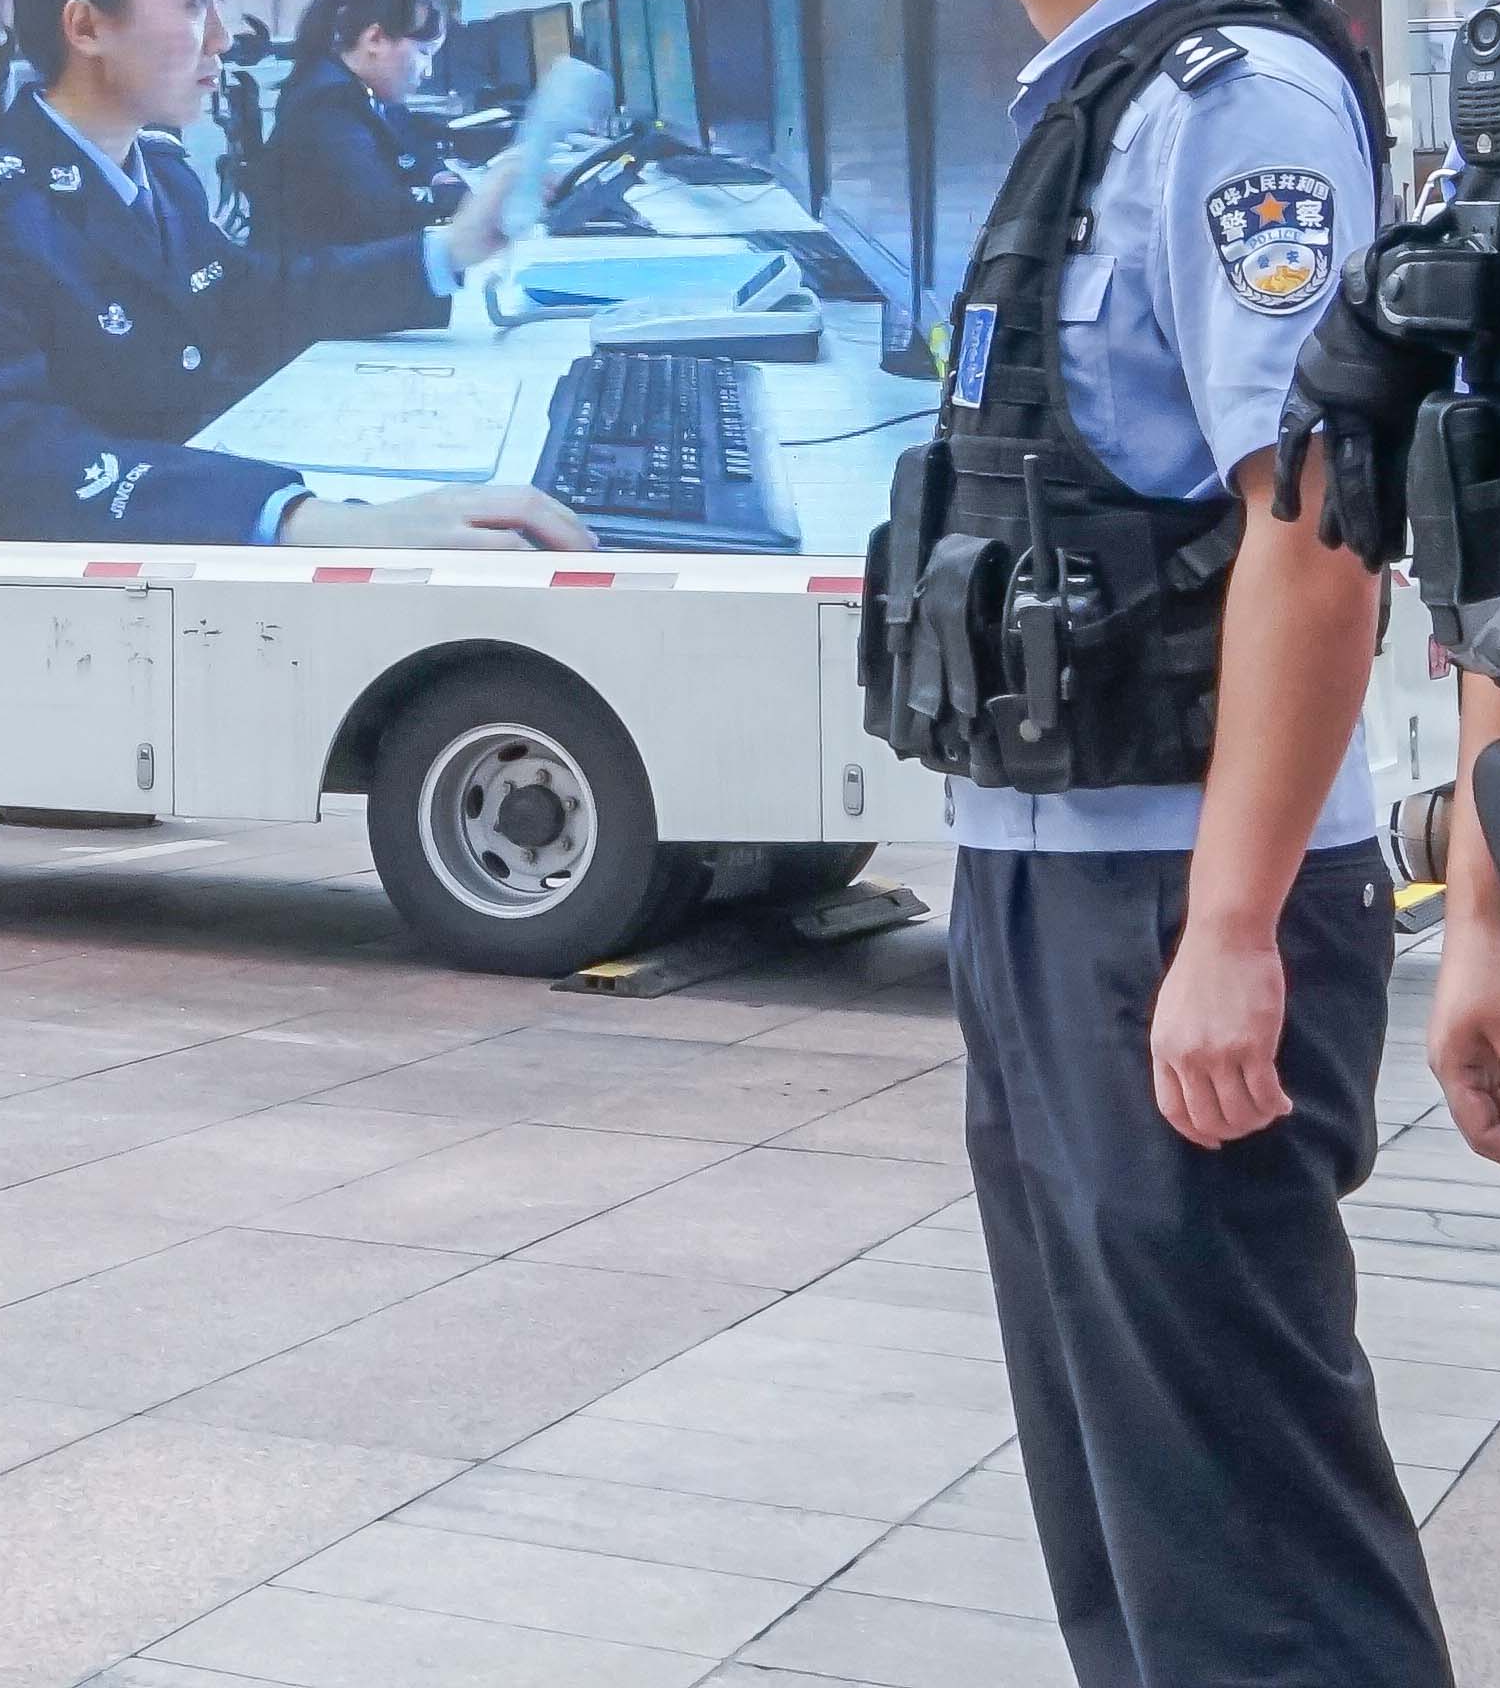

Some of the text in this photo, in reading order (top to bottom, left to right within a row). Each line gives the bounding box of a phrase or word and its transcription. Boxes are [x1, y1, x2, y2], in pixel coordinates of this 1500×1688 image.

[1208, 173, 1330, 218] 中华人民共和国
[1219, 199, 1325, 242] 警察
